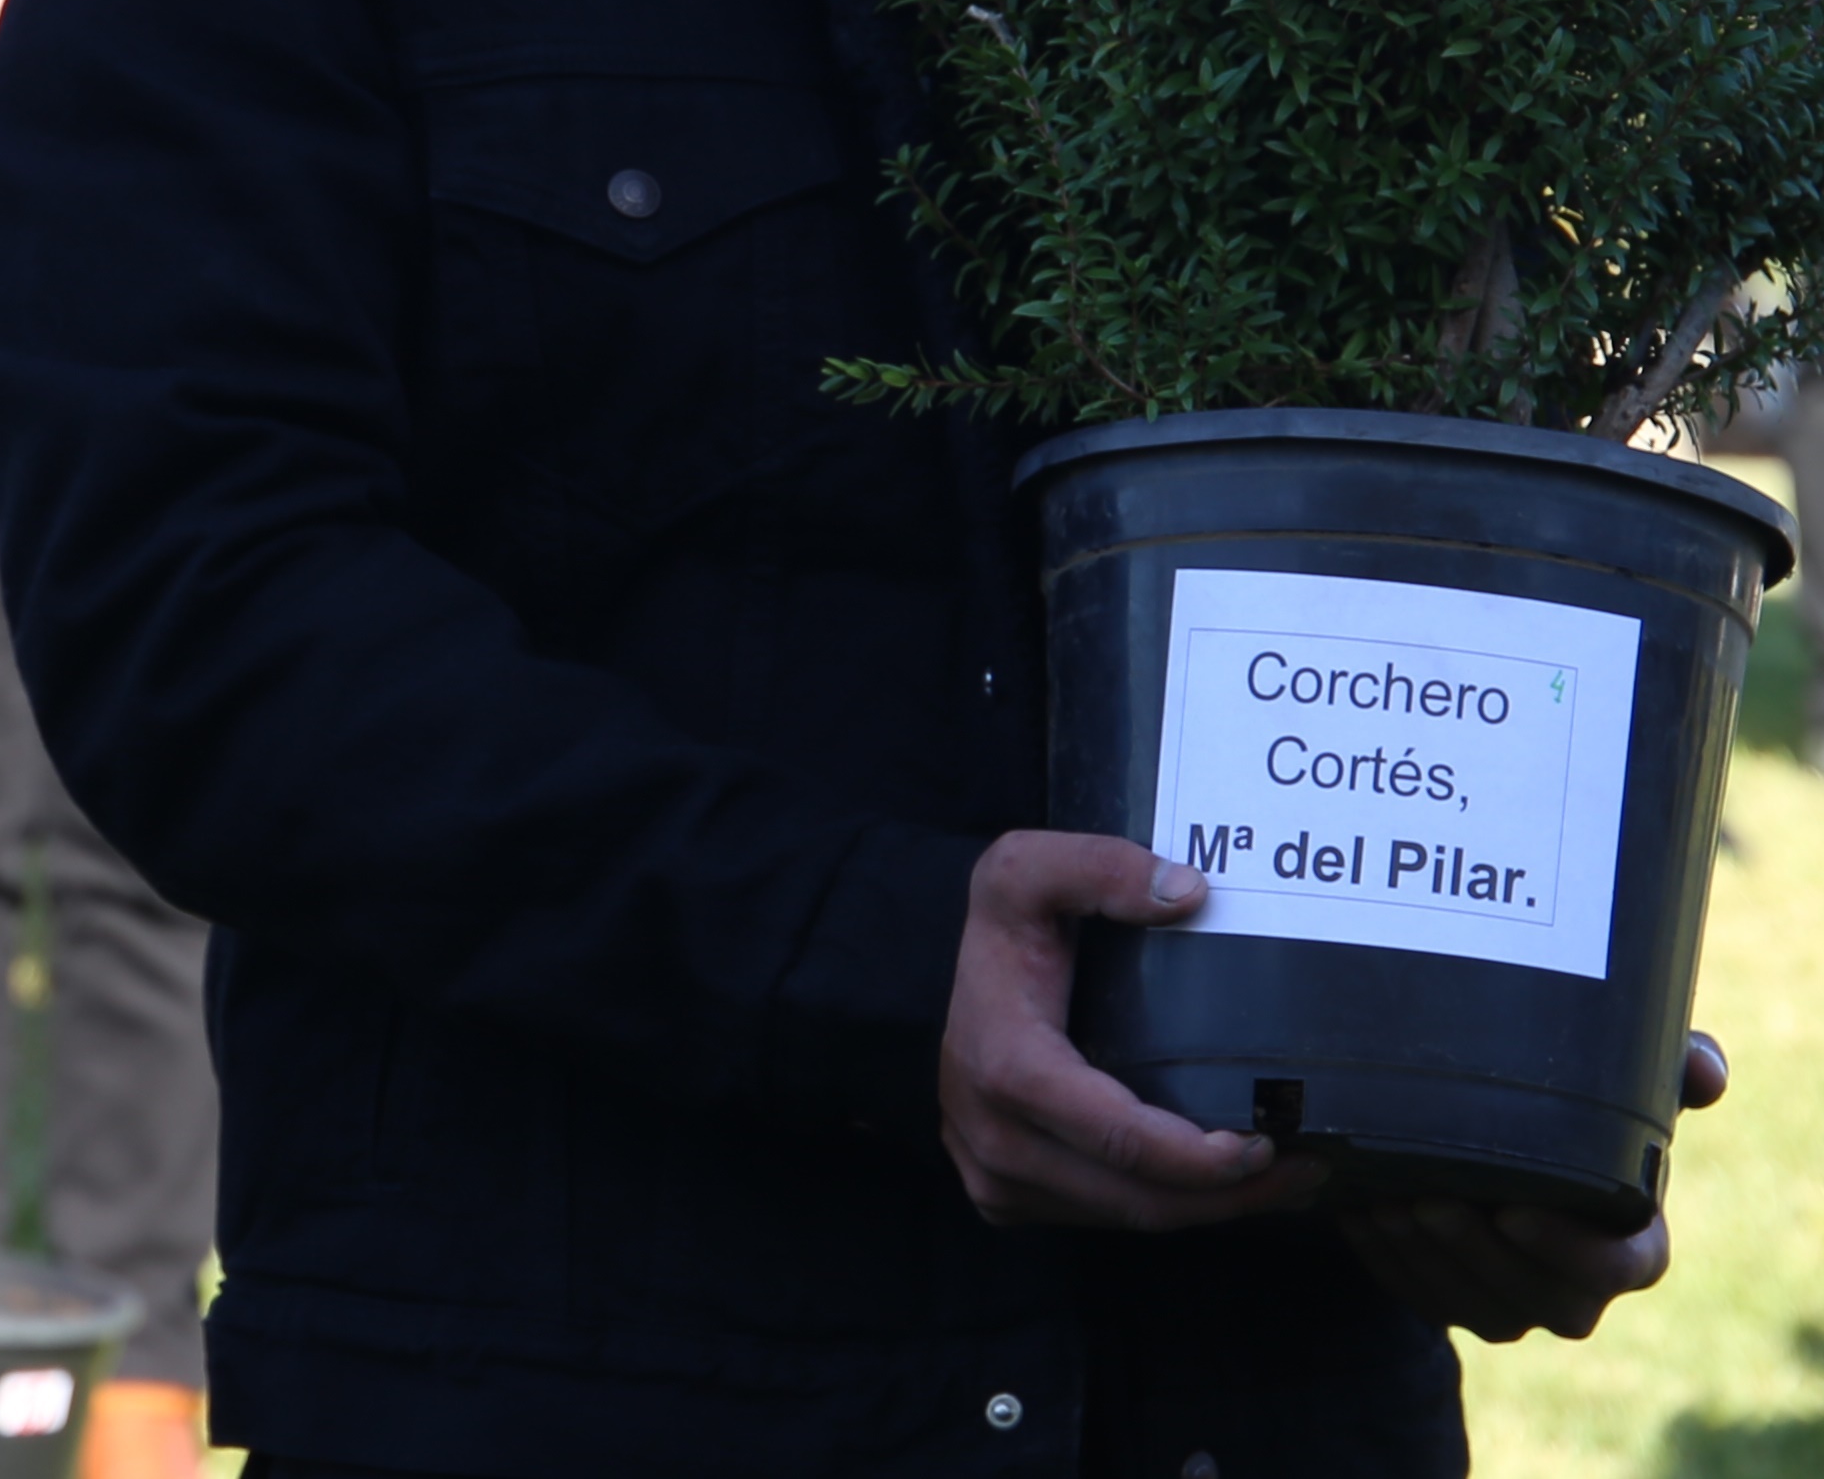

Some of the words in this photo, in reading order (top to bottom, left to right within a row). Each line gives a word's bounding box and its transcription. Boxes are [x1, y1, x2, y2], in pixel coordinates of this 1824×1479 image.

[1247, 650, 1510, 725] Corchero
[1266, 735, 1470, 812] Cortés,
[1186, 823, 1255, 875] Mª
[1272, 831, 1365, 886] del
[1386, 839, 1537, 908] Pilar.
